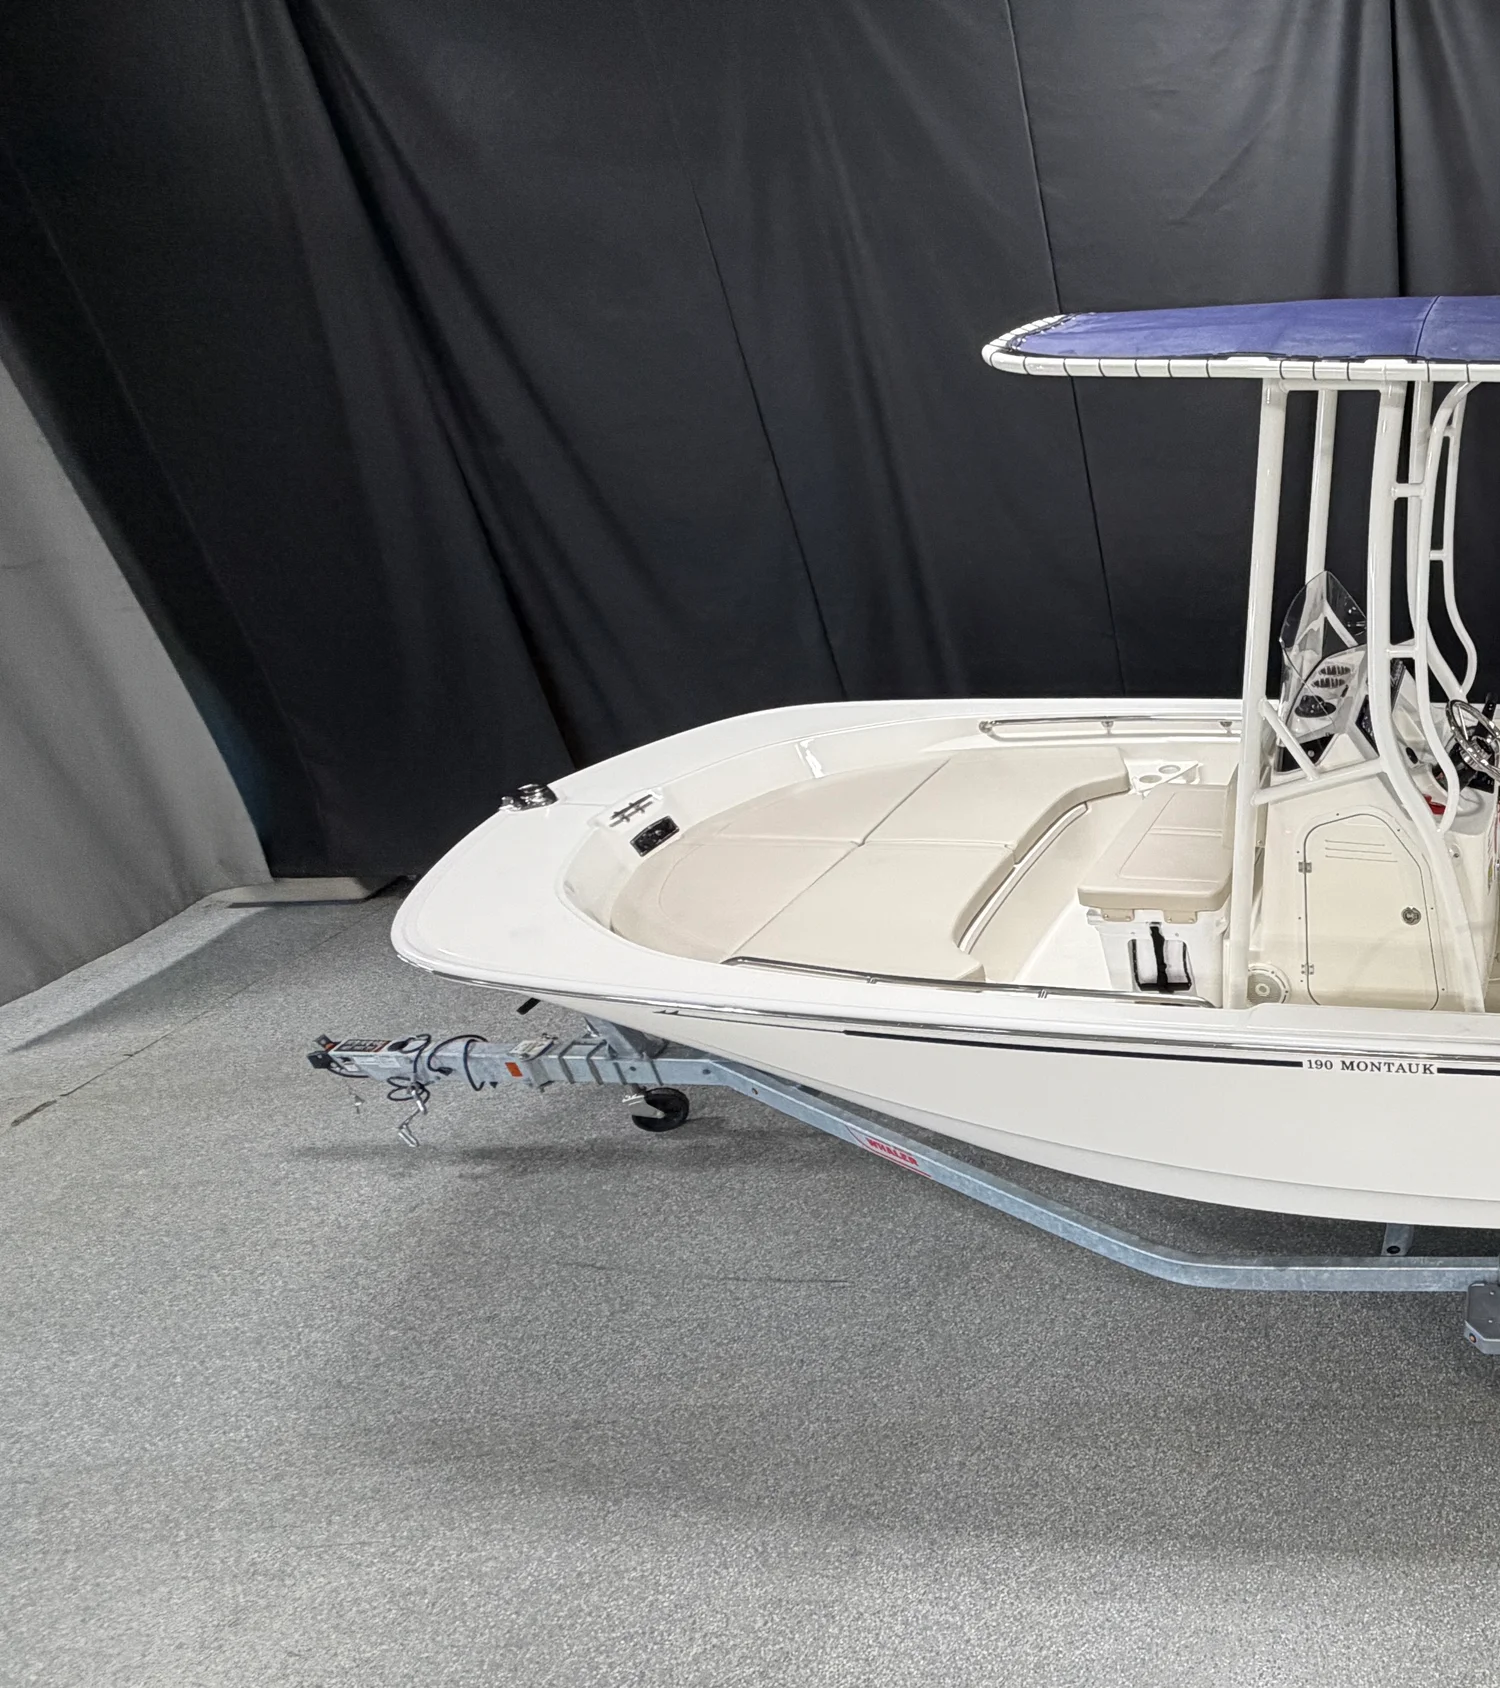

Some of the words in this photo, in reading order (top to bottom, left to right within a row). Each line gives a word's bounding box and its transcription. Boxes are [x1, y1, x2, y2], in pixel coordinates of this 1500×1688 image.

[1307, 1059, 1333, 1070] 190
[1341, 1060, 1435, 1075] MONTAUK
[866, 1137, 919, 1166] WHALER
